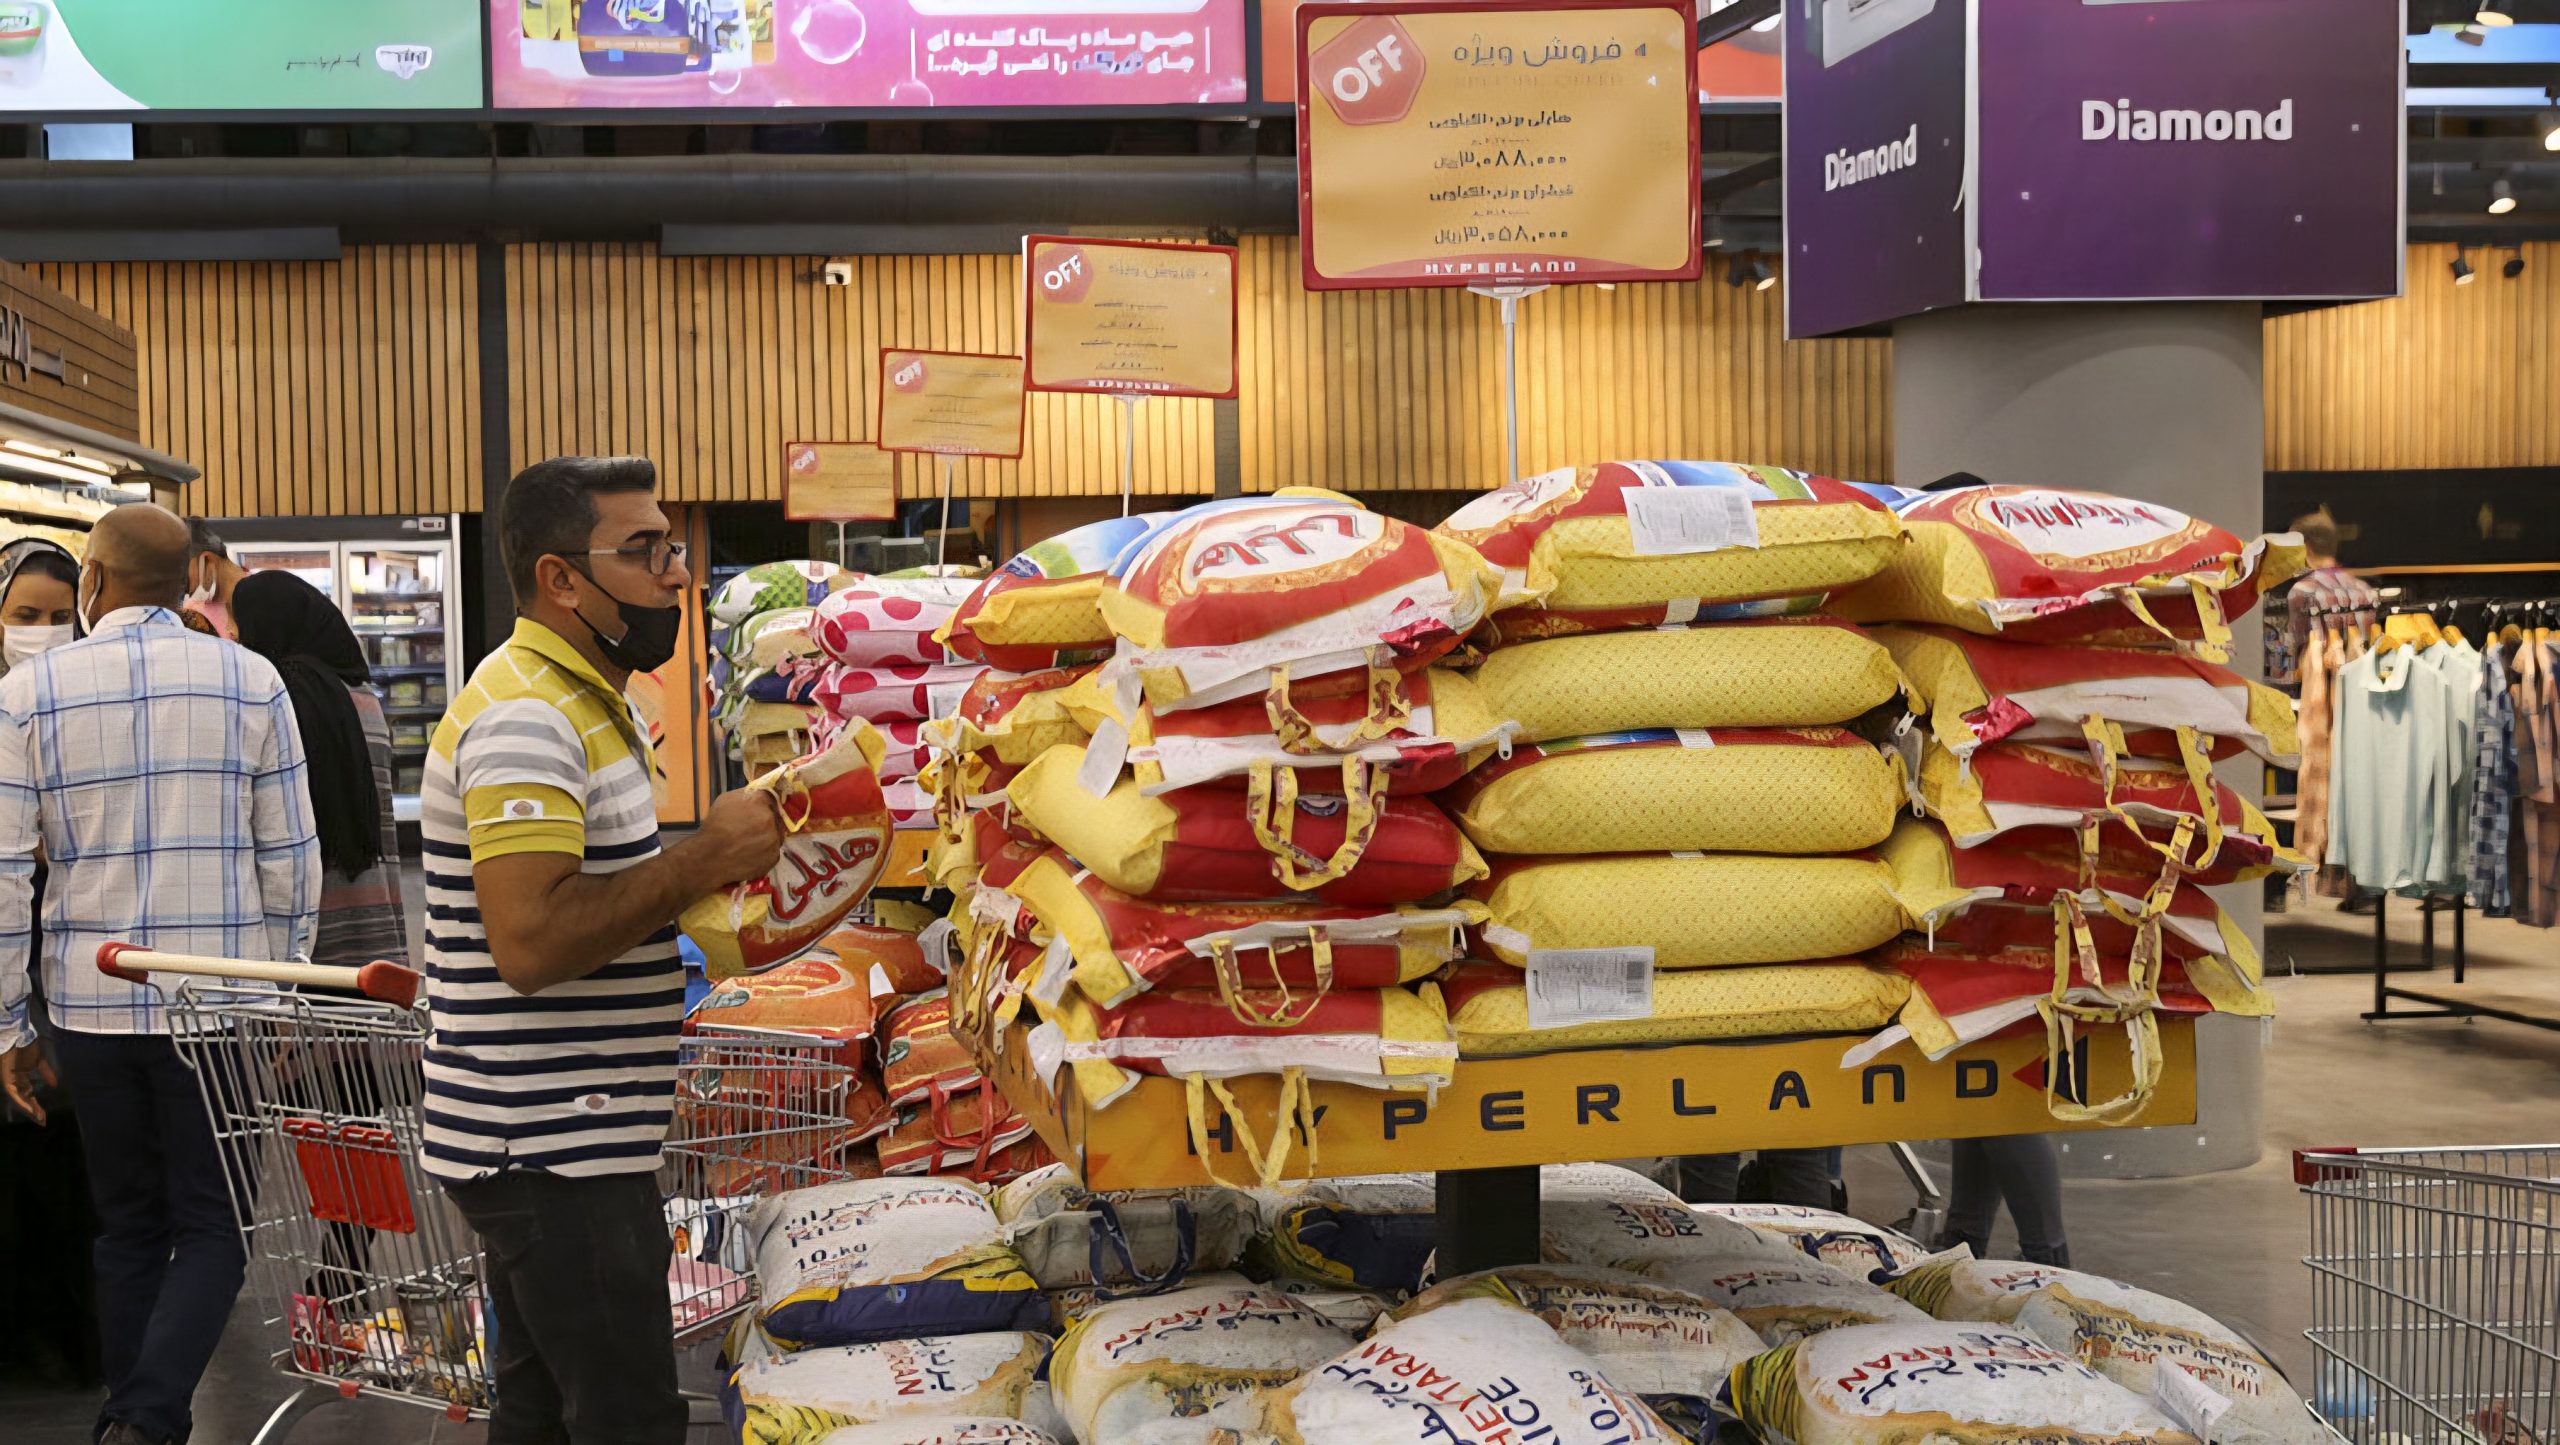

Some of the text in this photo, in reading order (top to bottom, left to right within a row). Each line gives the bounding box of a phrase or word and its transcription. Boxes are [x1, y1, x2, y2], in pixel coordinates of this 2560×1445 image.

[1332, 34, 1402, 102] OFF
[1454, 33, 1621, 67] فروش ویژه
[2081, 99, 2294, 141] Diamond
[1825, 124, 1917, 192] Diamond
[1044, 254, 1081, 290] OFF
[768, 836, 880, 924] هایلی
[1477, 1376, 1560, 1445] ICE
